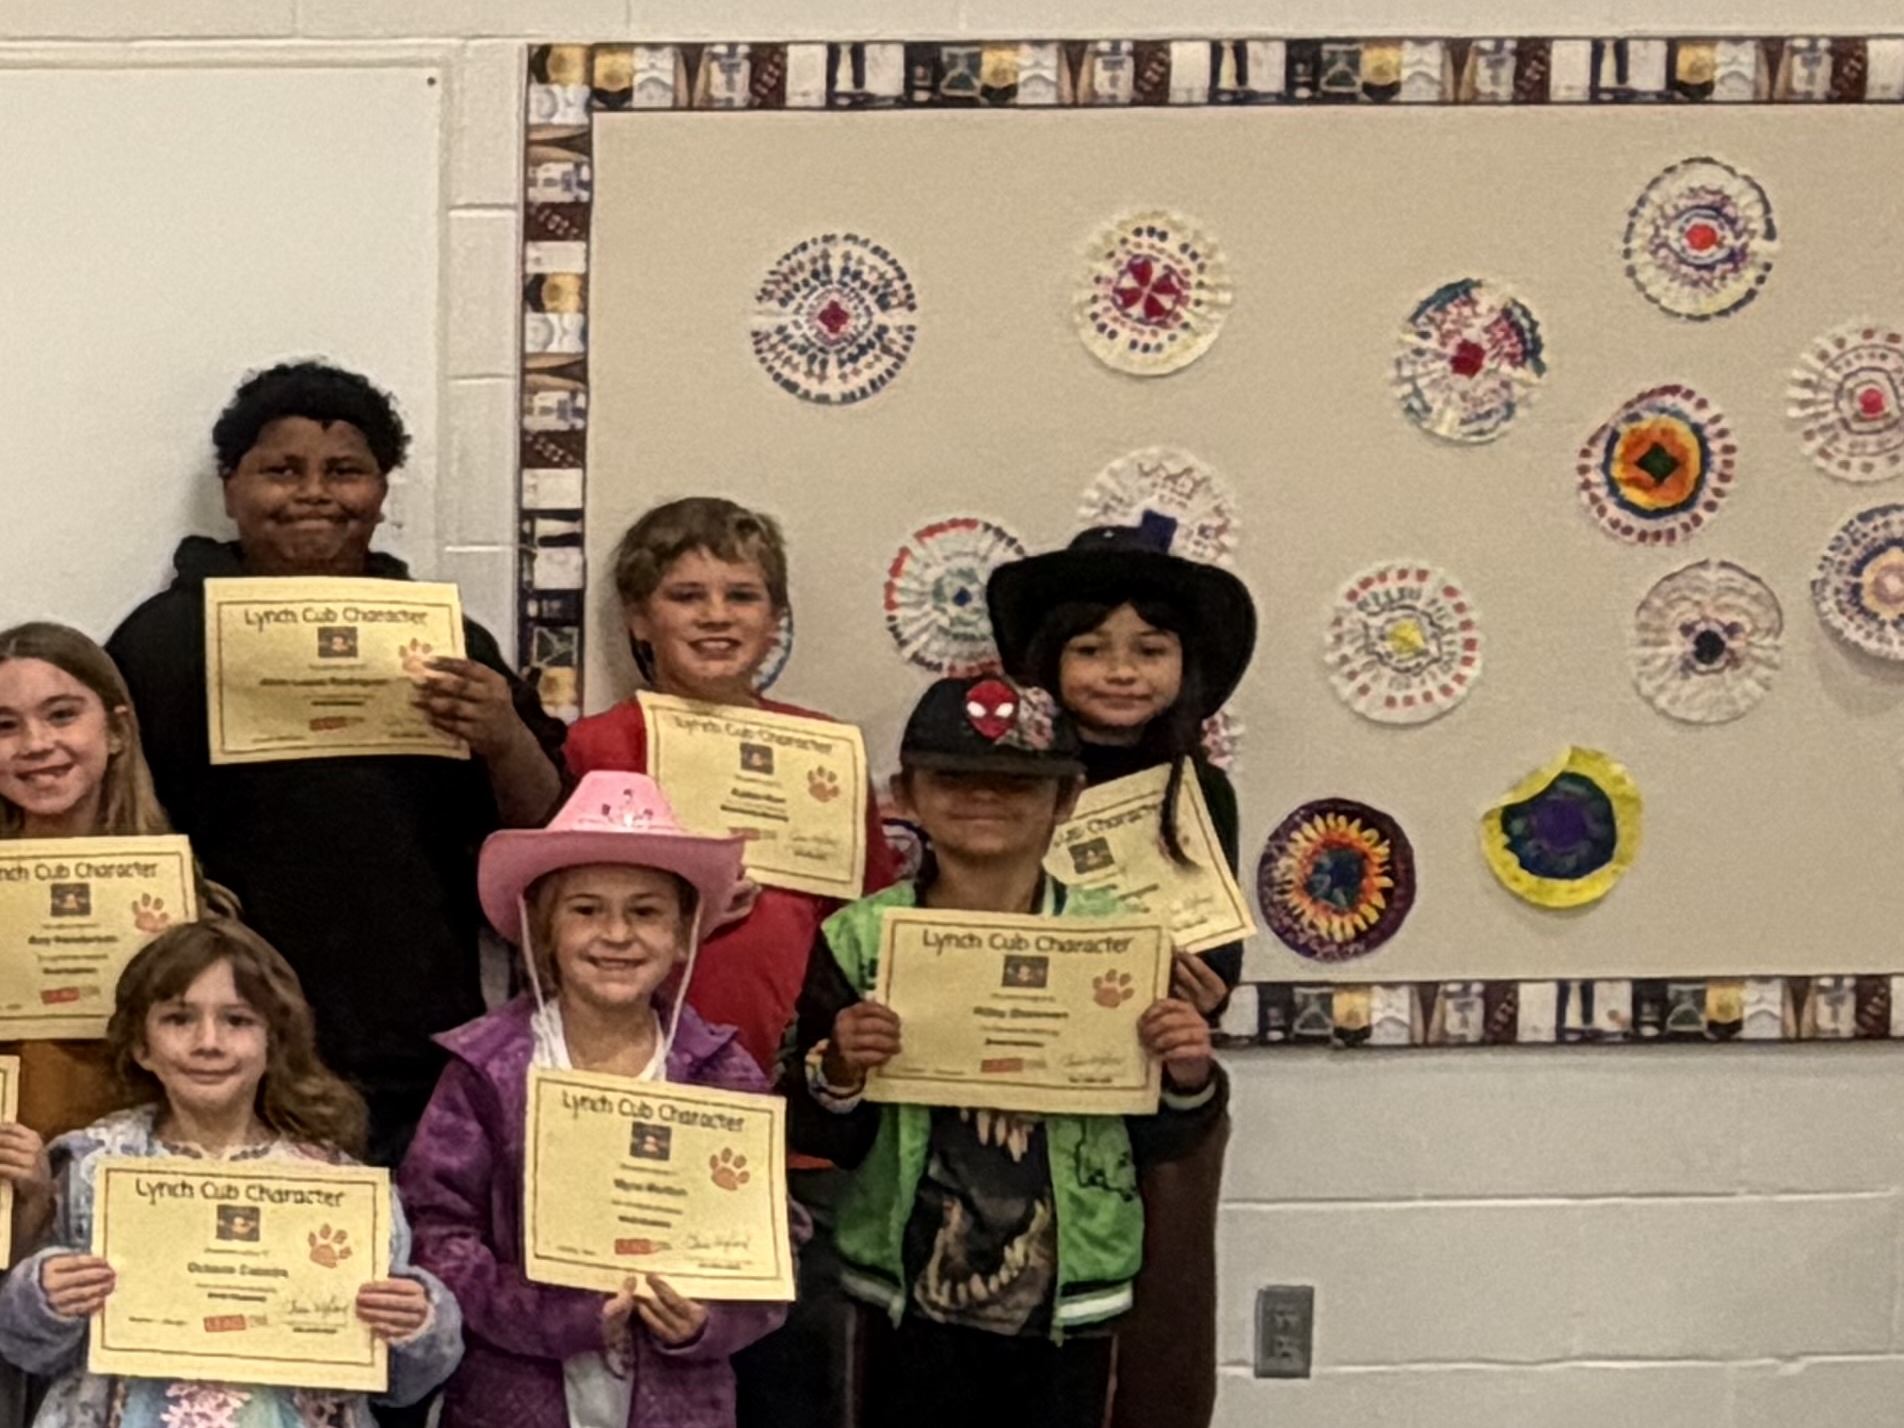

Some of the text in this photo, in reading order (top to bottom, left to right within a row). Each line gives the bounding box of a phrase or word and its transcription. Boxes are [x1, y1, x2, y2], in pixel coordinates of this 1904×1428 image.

[302, 607, 338, 623] Cub
[34, 863, 70, 879] Cub
[989, 932, 1029, 951] Cub
[618, 1098, 653, 1119] Cub
[200, 1181, 239, 1200] Cub
